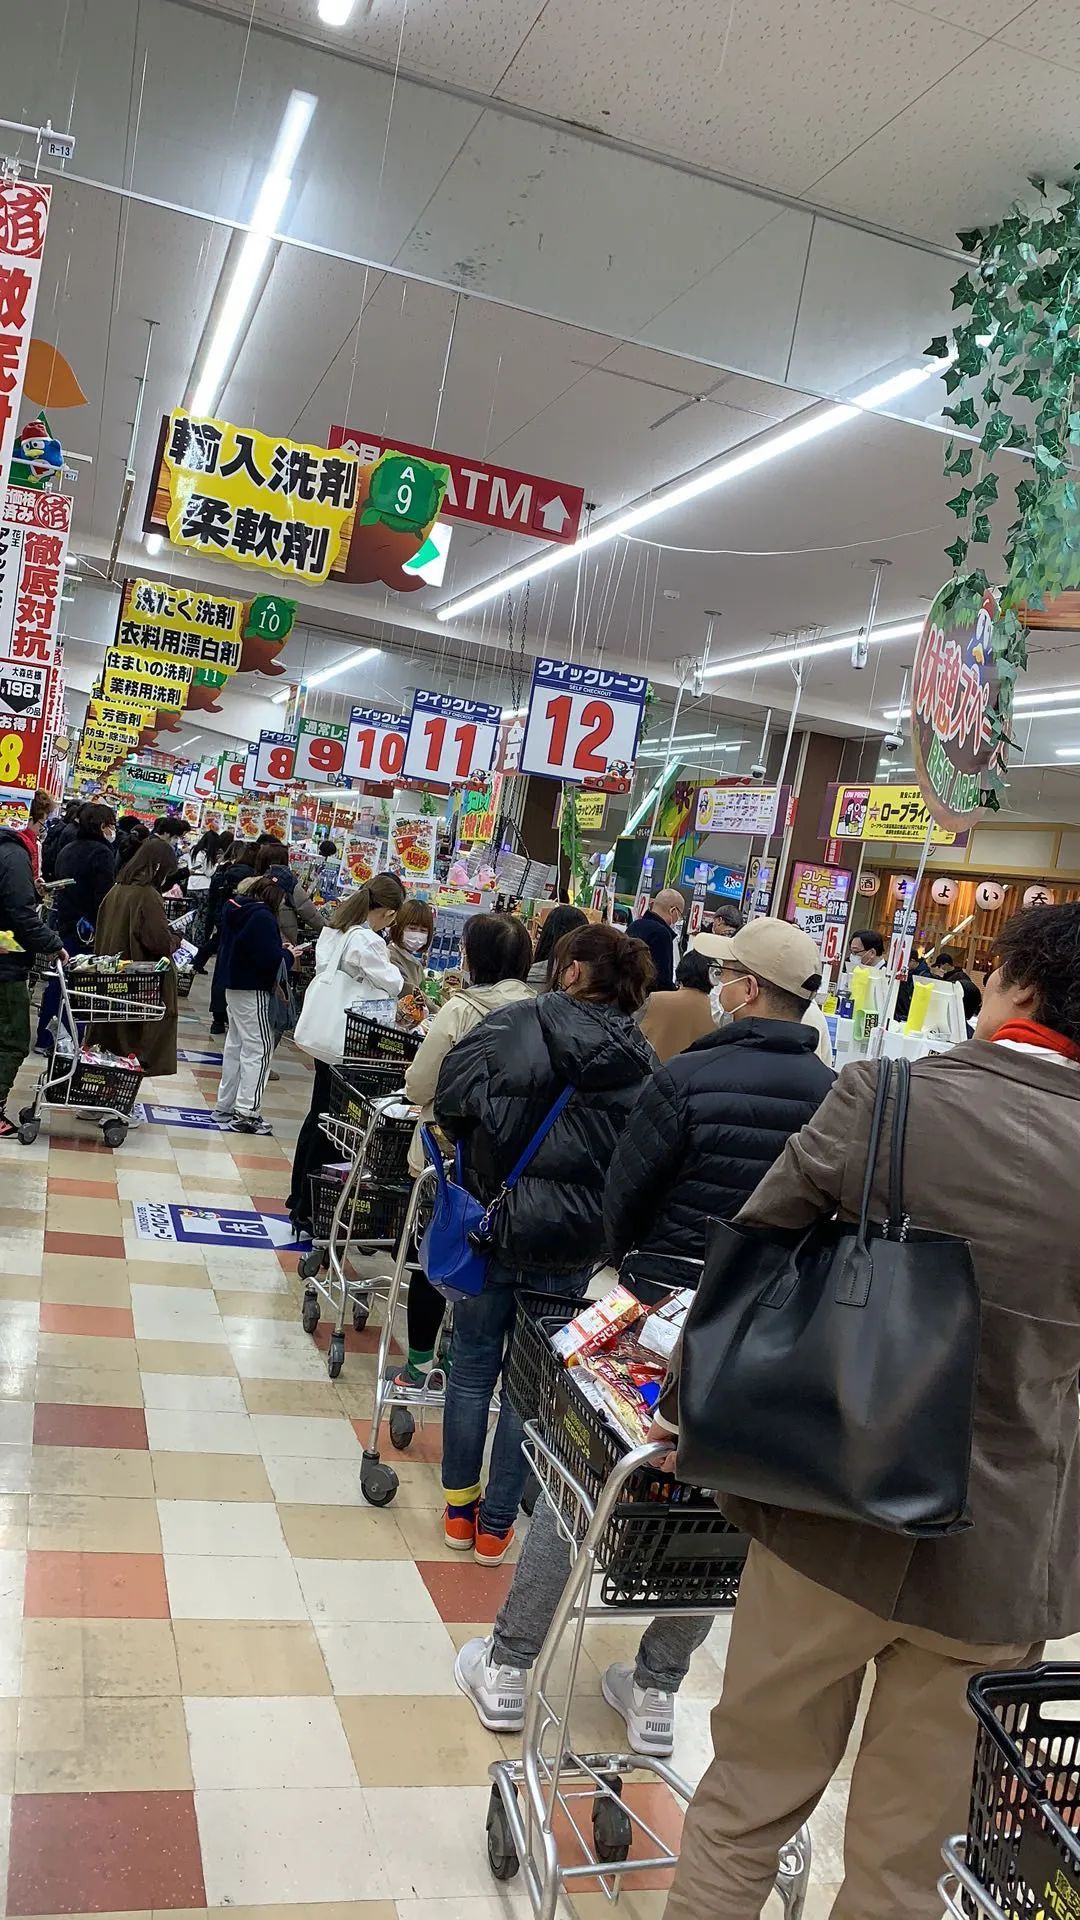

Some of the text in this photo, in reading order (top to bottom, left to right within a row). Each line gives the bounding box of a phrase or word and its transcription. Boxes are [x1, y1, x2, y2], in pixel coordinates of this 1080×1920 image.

[51, 143, 70, 156] R-13
[168, 417, 358, 509] 輸入洗剤
[400, 466, 416, 483] A
[395, 484, 413, 515] 9
[11, 529, 22, 548] 花王
[182, 493, 331, 574] 柔軟剤
[12, 531, 64, 661] 徹底対抗
[135, 585, 235, 630] 洗たく洗剤
[267, 602, 277, 612] A
[258, 611, 281, 633] 10
[121, 620, 240, 668] 衣料用漂白剤
[12, 667, 42, 680] 大森店様
[107, 651, 193, 683] 住まいの洗剤
[203, 669, 218, 683] 11
[538, 660, 645, 693] クイックレーン
[110, 677, 182, 706] 業務用洗剤
[569, 684, 613, 697] SELF CHECKOUT
[917, 623, 1008, 776] 休憩スペ
[26, 707, 41, 717] の品
[417, 691, 500, 718] クイックレーン
[102, 708, 142, 727] 芳香剤
[545, 694, 615, 774] 12
[88, 740, 123, 755] ハブラシ
[308, 738, 344, 772] 9
[357, 728, 406, 775] 10
[424, 717, 477, 777] 11
[126, 766, 167, 785] 大森山王店
[267, 747, 295, 780] 8
[926, 732, 955, 804] REST
[18, 773, 37, 788] +税
[861, 878, 873, 890] 酒
[982, 887, 999, 902] い
[805, 914, 823, 925] 次回
[824, 926, 838, 959] 15
[107, 982, 128, 990] MEGA
[497, 1697, 523, 1709] PUMA
[645, 1721, 671, 1733] PUMA
